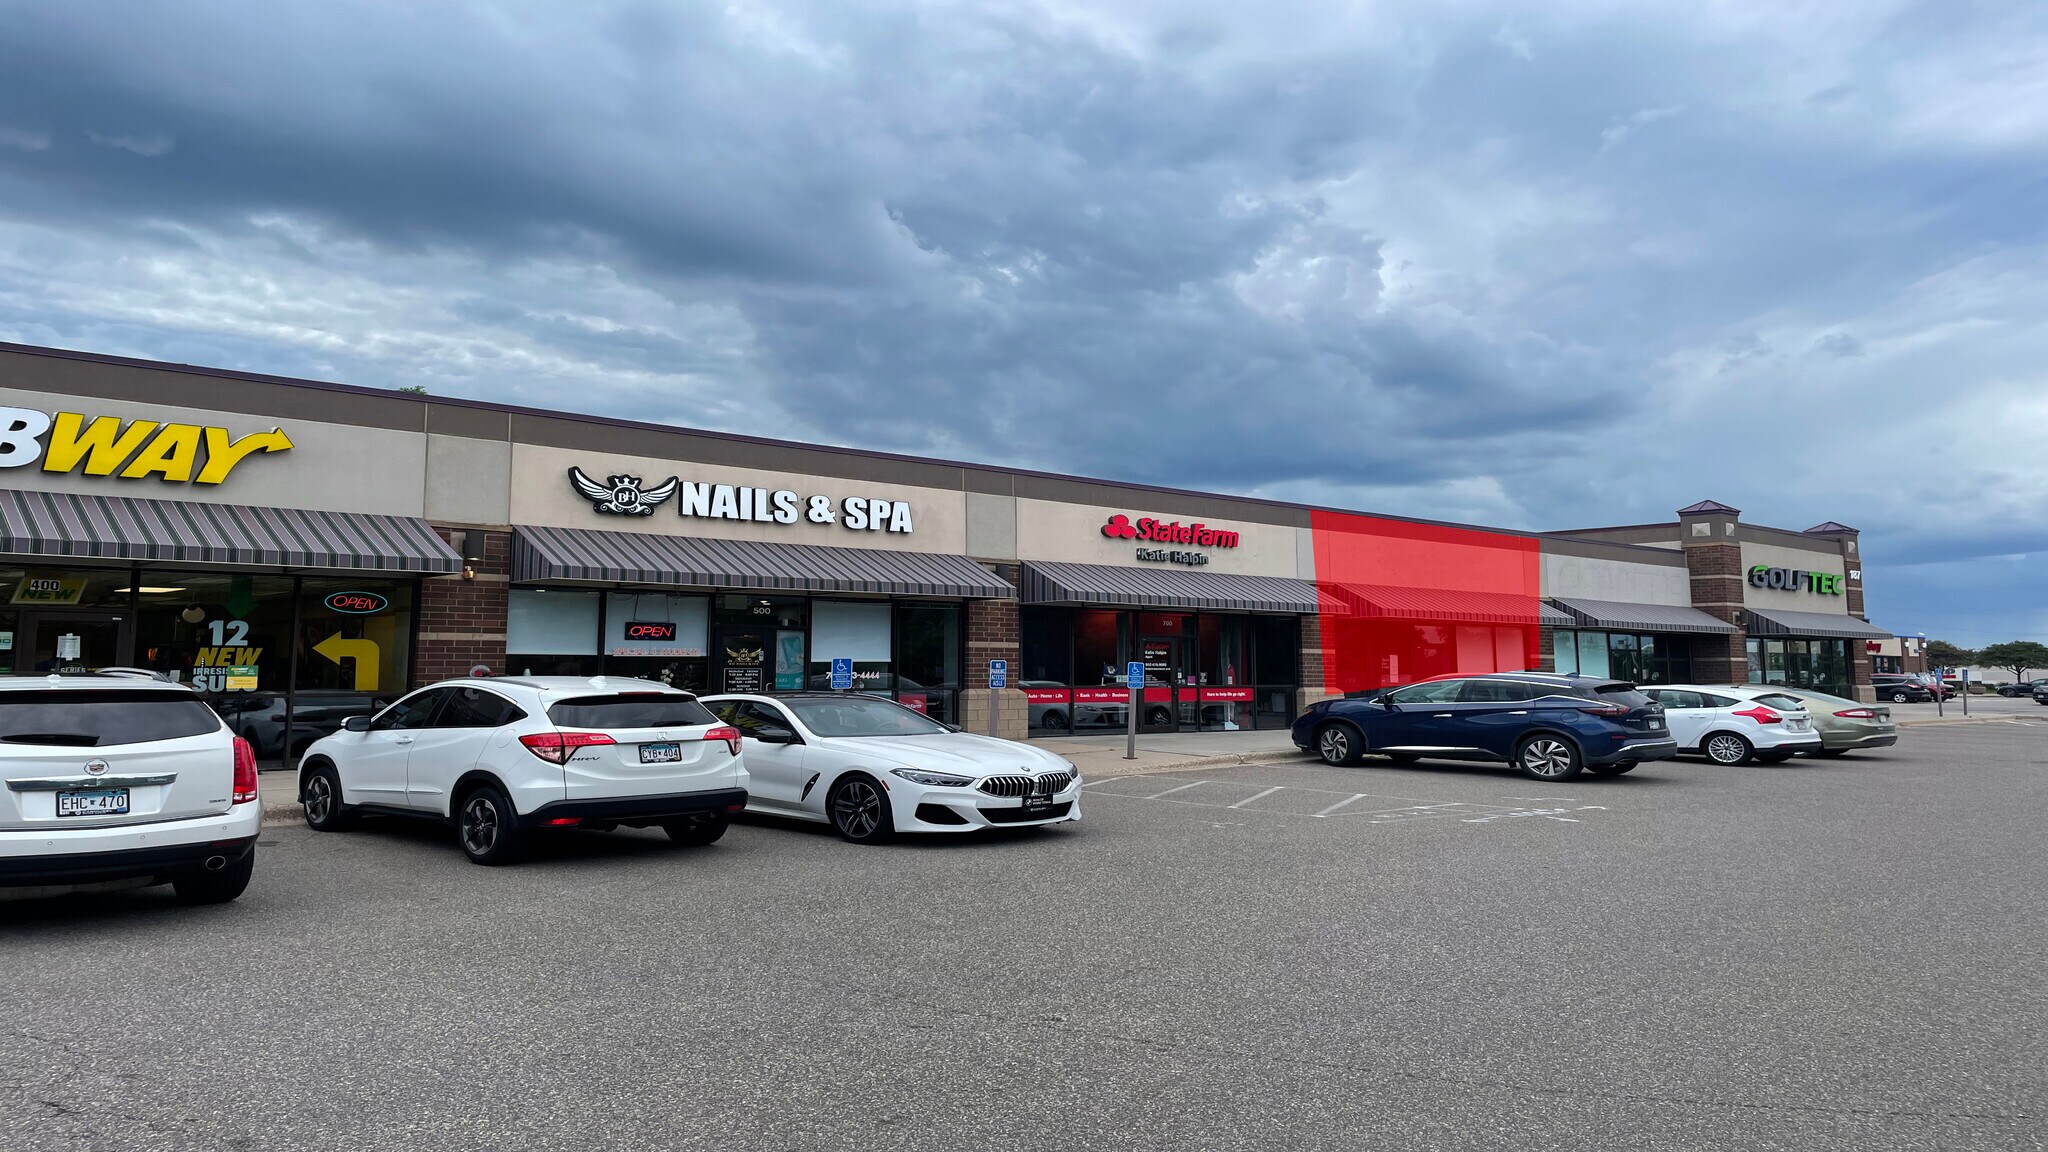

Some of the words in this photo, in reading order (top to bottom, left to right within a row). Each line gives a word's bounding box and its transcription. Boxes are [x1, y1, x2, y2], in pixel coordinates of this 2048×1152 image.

[679, 480, 799, 524] NAILS
[806, 495, 836, 524] &
[842, 496, 913, 533] SPA
[1139, 548, 1170, 561] Katie
[1173, 551, 1209, 565] Halpin
[31, 580, 60, 591] 400
[1748, 564, 1844, 595] GOLFTEC
[21, 589, 76, 600] NEW
[333, 595, 378, 610] OPEN
[753, 607, 771, 615] 500
[208, 619, 249, 646] 12
[630, 625, 672, 637] OPEN
[194, 647, 263, 667] NEW
[193, 667, 228, 675] IRRESI
[663, 748, 678, 758] 404
[61, 797, 88, 810] EHC
[99, 795, 125, 809] 470
